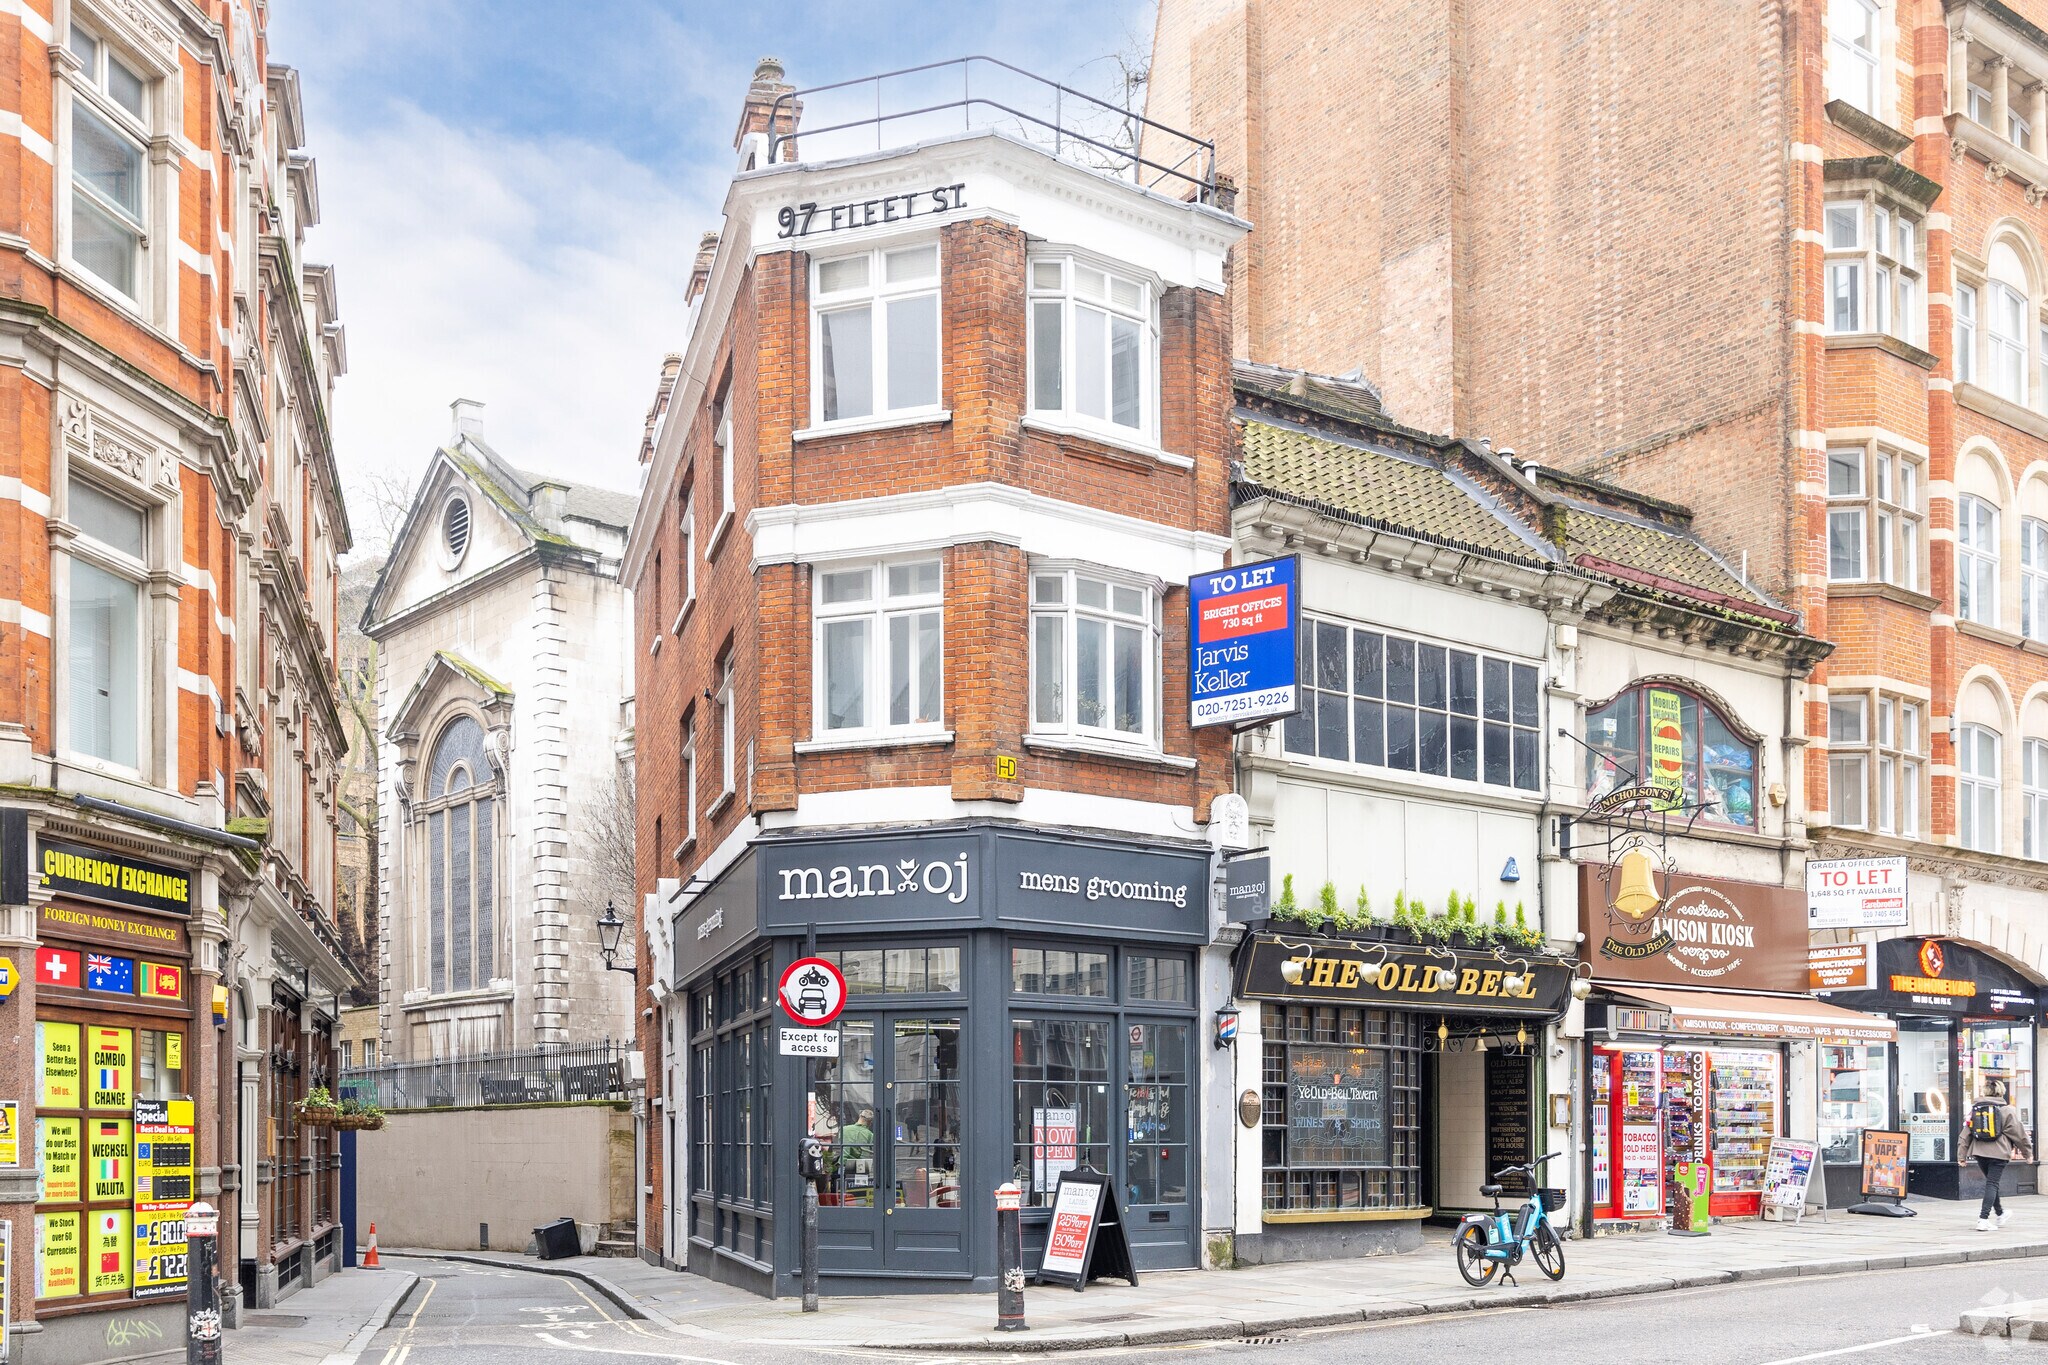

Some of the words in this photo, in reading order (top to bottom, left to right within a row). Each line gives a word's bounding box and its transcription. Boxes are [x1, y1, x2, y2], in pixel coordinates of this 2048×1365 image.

[778, 202, 817, 239] 97
[831, 192, 918, 231] FLEET
[932, 182, 967, 213] ST.
[1210, 574, 1236, 595] TO
[1241, 566, 1275, 589] LET
[1203, 604, 1239, 620] BRIGHT
[1241, 596, 1282, 613] OFFICES
[1222, 617, 1240, 629] 730
[1241, 616, 1253, 627] sq
[1254, 613, 1263, 623] ft
[1195, 640, 1249, 674] Jarvis
[1195, 669, 1251, 695] Keller
[1197, 691, 1289, 717] 020-7251-9226
[1652, 695, 1678, 711] MOBILES
[1654, 743, 1680, 757] REPAIRS
[1601, 787, 1670, 809] NICHOLSON'S
[1811, 861, 1838, 869] GRADE
[1847, 860, 1874, 868] OFFICE
[44, 849, 120, 888] CURRENCY
[121, 866, 188, 903] EXCHANGE
[1820, 871, 1848, 887] TO
[1857, 869, 1892, 885] LET
[1020, 871, 1080, 893] mens
[1087, 876, 1187, 908] grooming
[1857, 887, 1902, 895] AVAILABLE
[44, 907, 90, 925] FOREIGN
[91, 915, 126, 932] MONEY
[128, 922, 177, 941] EXCHANGE
[1651, 916, 1708, 943] AMISON
[1711, 922, 1755, 948] KIOSK
[1289, 956, 1363, 989] THE
[1376, 962, 1444, 993] OLD
[1690, 967, 1725, 978] ACCESSORIES
[1817, 968, 1853, 977] TOBACCO
[1683, 1018, 1708, 1029] AMISON
[1708, 1020, 1727, 1030] KIOSK
[1731, 1021, 1779, 1033] CONFECTIONERY
[1783, 1025, 1810, 1035] TOBACCO
[1813, 1027, 1831, 1036] VAPES
[1834, 1027, 1855, 1037] MOBILE
[1855, 1029, 1892, 1039] ACCESSORIES
[781, 1031, 818, 1043] Except
[823, 1032, 837, 1043] for
[52, 1042, 66, 1052] Seen
[67, 1044, 71, 1052] a
[791, 1044, 828, 1053] access
[46, 1054, 64, 1064] Better
[64, 1056, 77, 1065] Rate
[94, 1051, 126, 1067] CAMBIO
[45, 1067, 77, 1078] Elsewhere?
[1693, 1053, 1703, 1112] TOBACCO
[51, 1086, 61, 1095] Tell
[94, 1091, 126, 1105] CHANGE
[136, 1110, 168, 1125] Special
[1295, 1118, 1324, 1128] WINES
[1350, 1118, 1380, 1129] SPIRITS
[51, 1126, 61, 1135] We
[61, 1126, 72, 1135] will
[140, 1125, 154, 1133] Best
[1034, 1128, 1074, 1144] NOW
[45, 1139, 53, 1148] do
[54, 1140, 64, 1148] our
[64, 1139, 77, 1147] Best
[1624, 1133, 1656, 1142] TOBACCO
[1693, 1122, 1703, 1164] DRINKS
[45, 1152, 52, 1160] to
[52, 1151, 69, 1160] Match
[92, 1143, 129, 1158] WECHSEL
[1035, 1145, 1073, 1159] OPEN
[1623, 1144, 1639, 1153] SOLD
[1640, 1144, 1657, 1152] HERE
[1874, 1143, 1897, 1156] VAPE
[52, 1164, 65, 1173] Beat
[65, 1164, 70, 1173] it
[95, 1181, 125, 1196] VALUTA
[49, 1218, 58, 1228] We
[59, 1218, 75, 1227] Stock
[52, 1232, 64, 1242] over
[64, 1231, 73, 1241] 60
[46, 1246, 77, 1257] Currencies
[50, 1267, 63, 1276] Same
[64, 1266, 74, 1275] Day
[48, 1278, 76, 1287] Availability
